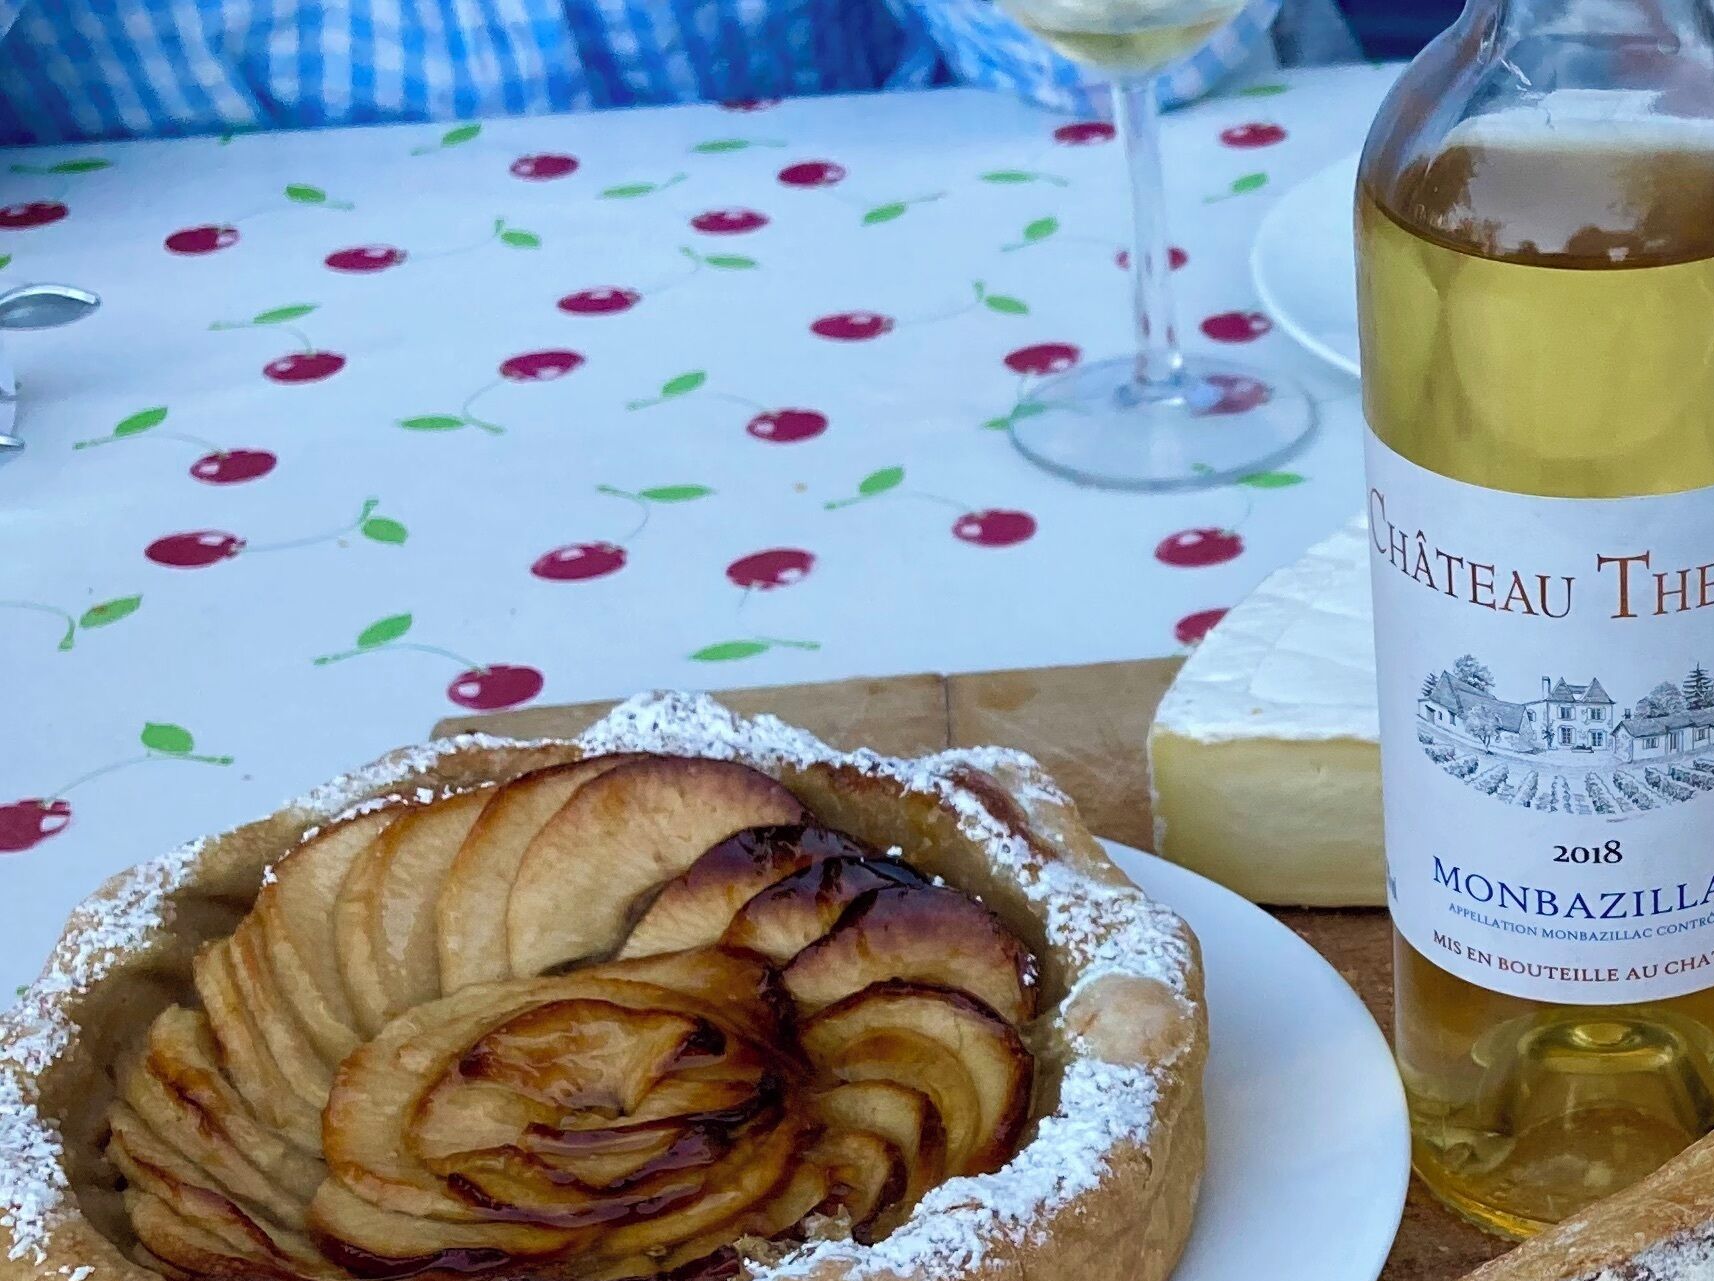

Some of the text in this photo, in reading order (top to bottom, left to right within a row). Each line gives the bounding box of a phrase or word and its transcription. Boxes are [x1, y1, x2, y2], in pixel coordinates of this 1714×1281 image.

[1370, 488, 1576, 618] CHÂTEAU
[1552, 839, 1623, 864] 2018
[1448, 902, 1537, 936] APPELLATION
[1541, 927, 1653, 942] MONBAZILLAC
[1433, 929, 1462, 955] MIS
[1467, 946, 1492, 967] EN
[1498, 956, 1619, 982] BOUTEILLE
[1625, 964, 1658, 981] AU
